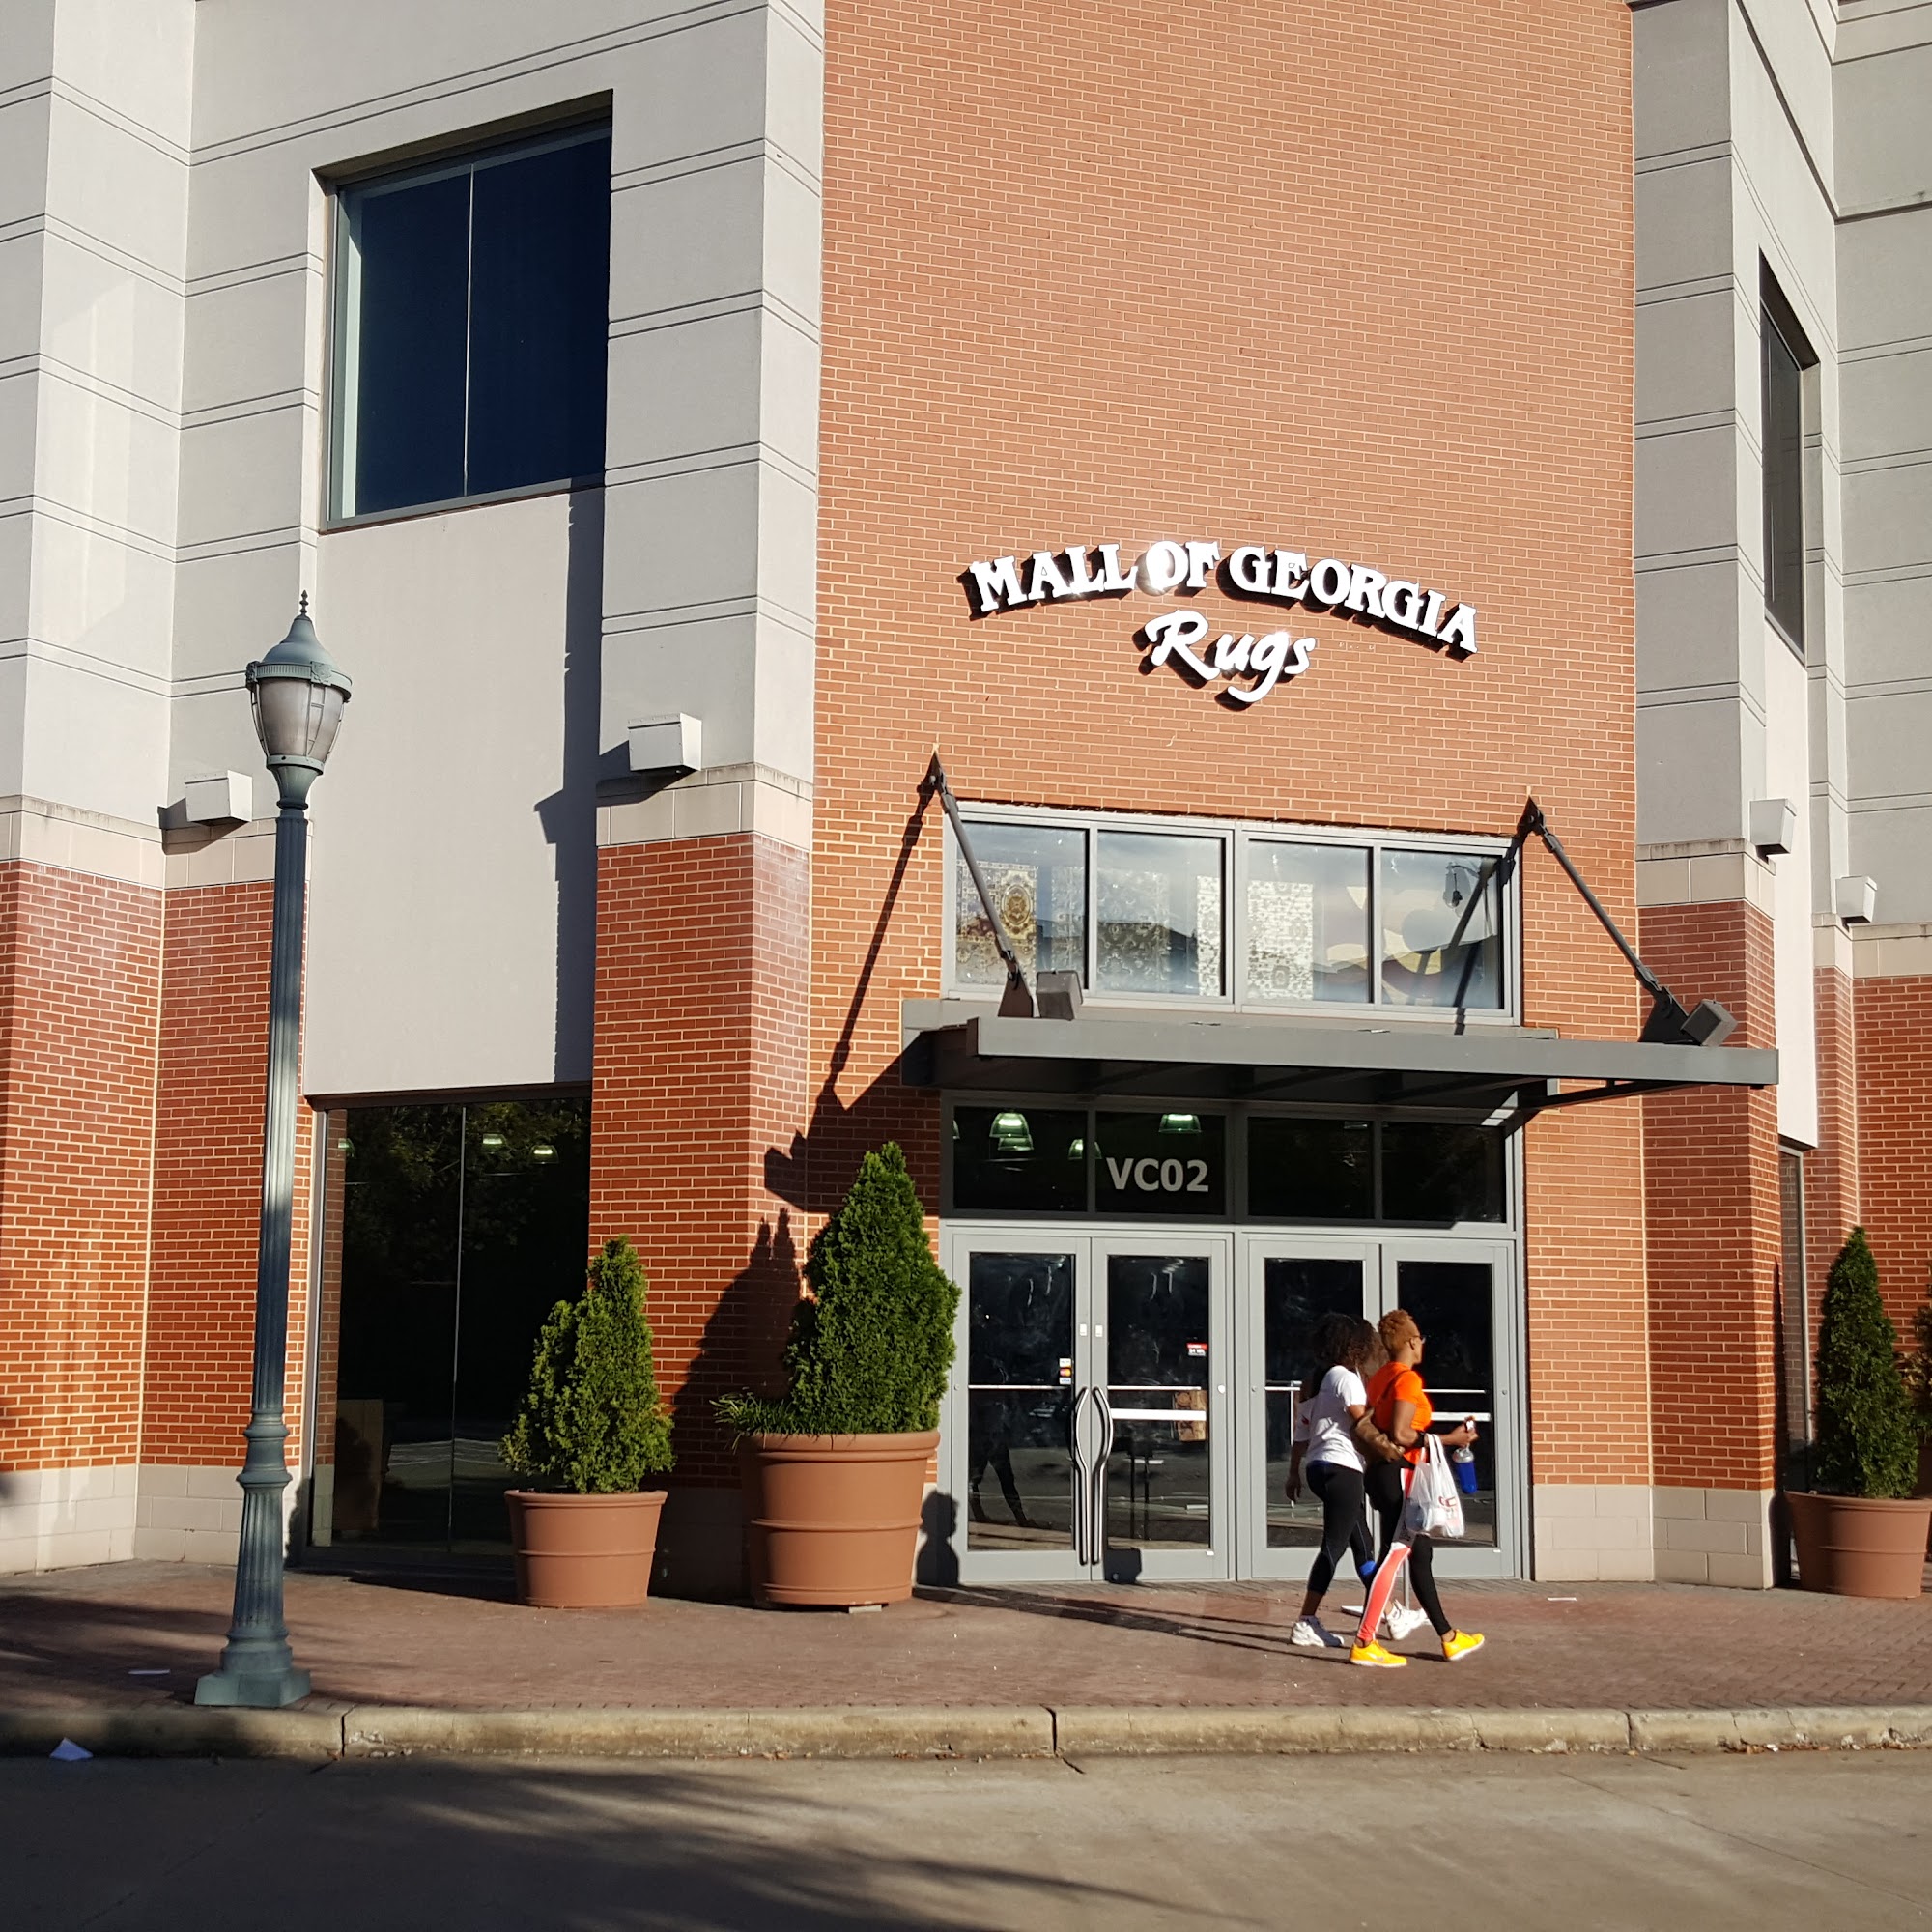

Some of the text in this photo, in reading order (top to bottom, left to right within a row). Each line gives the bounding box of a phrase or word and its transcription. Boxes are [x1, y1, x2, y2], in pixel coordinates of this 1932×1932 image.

[969, 541, 1479, 654] MALL OF GEORGIA
[1145, 609, 1317, 703] Rugs
[1105, 1157, 1209, 1192] VC02
